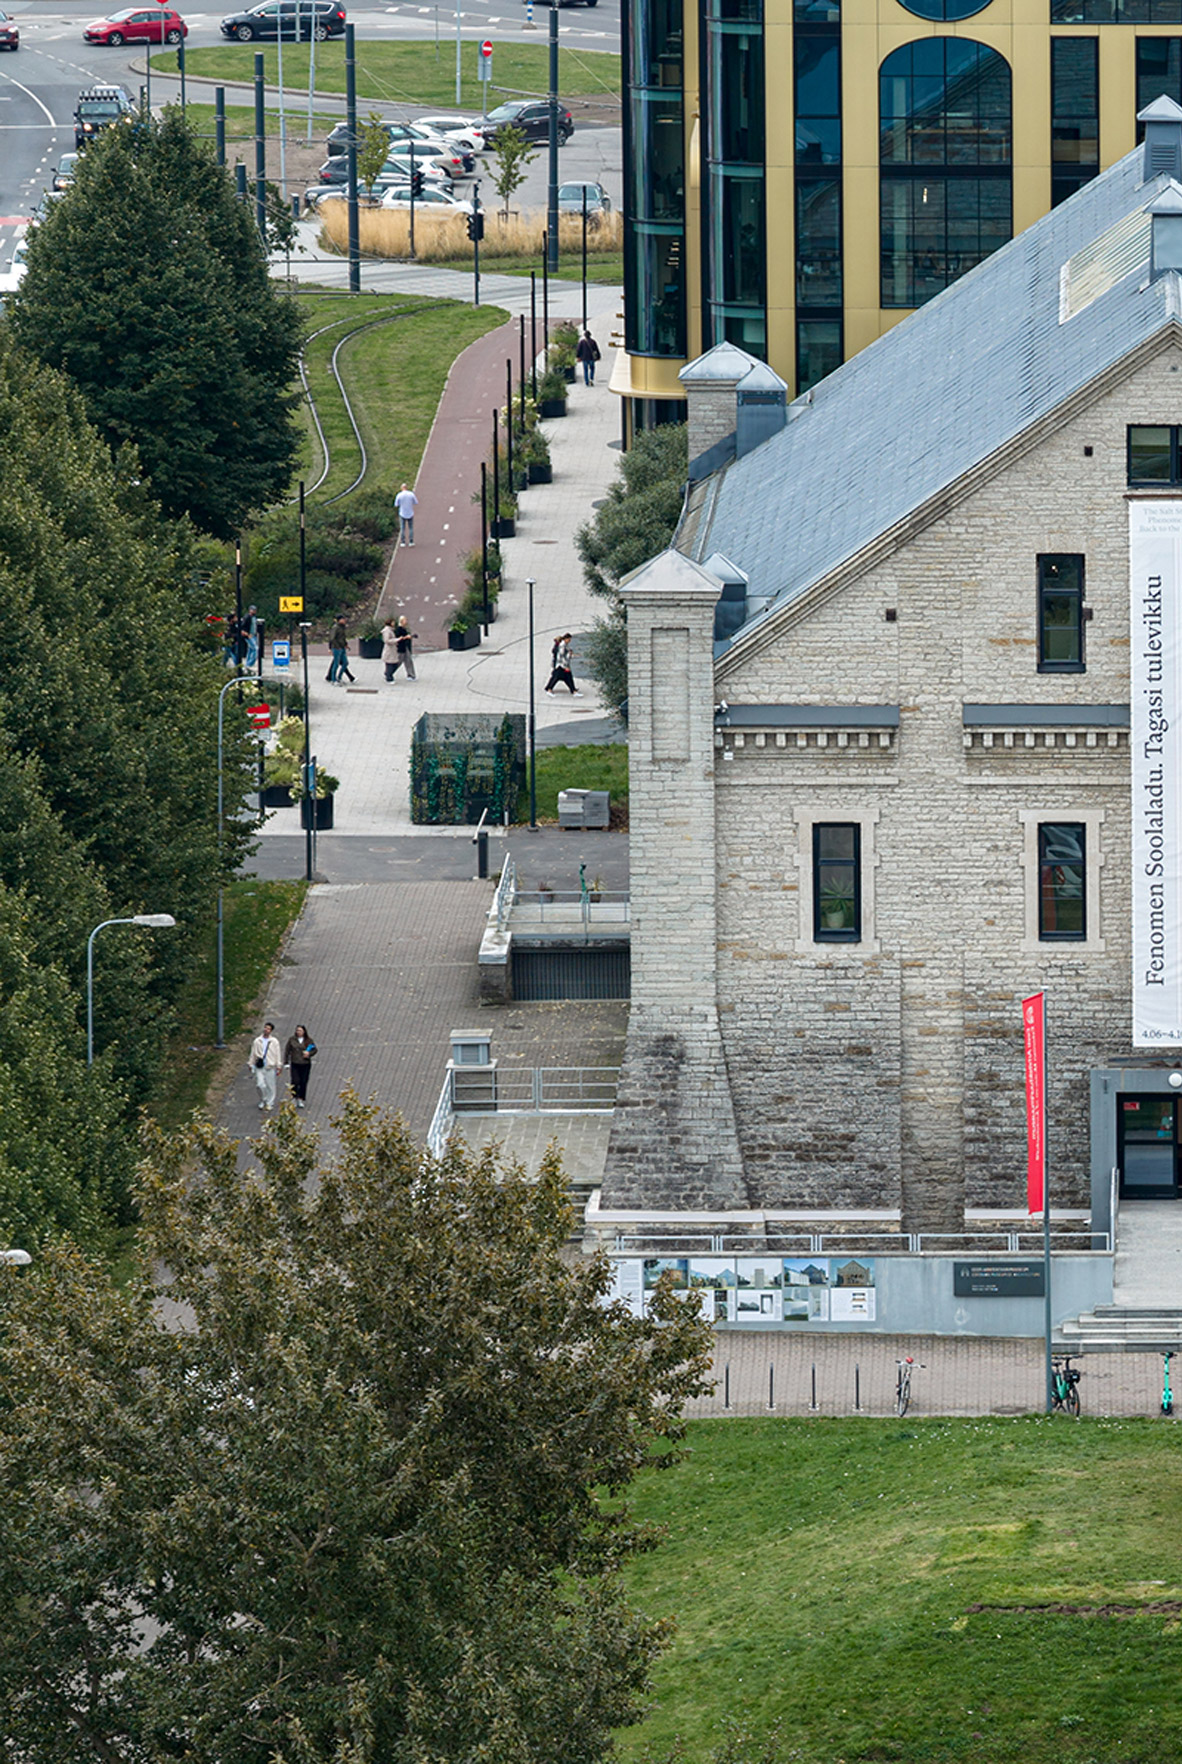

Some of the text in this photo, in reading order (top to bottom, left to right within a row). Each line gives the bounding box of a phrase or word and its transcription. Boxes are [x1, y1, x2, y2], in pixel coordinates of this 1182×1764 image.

[1159, 507, 1174, 515] Salt
[1139, 525, 1157, 533] Back
[1142, 575, 1169, 987] Fenomen Soolaladu. Tagasi tulevikku
